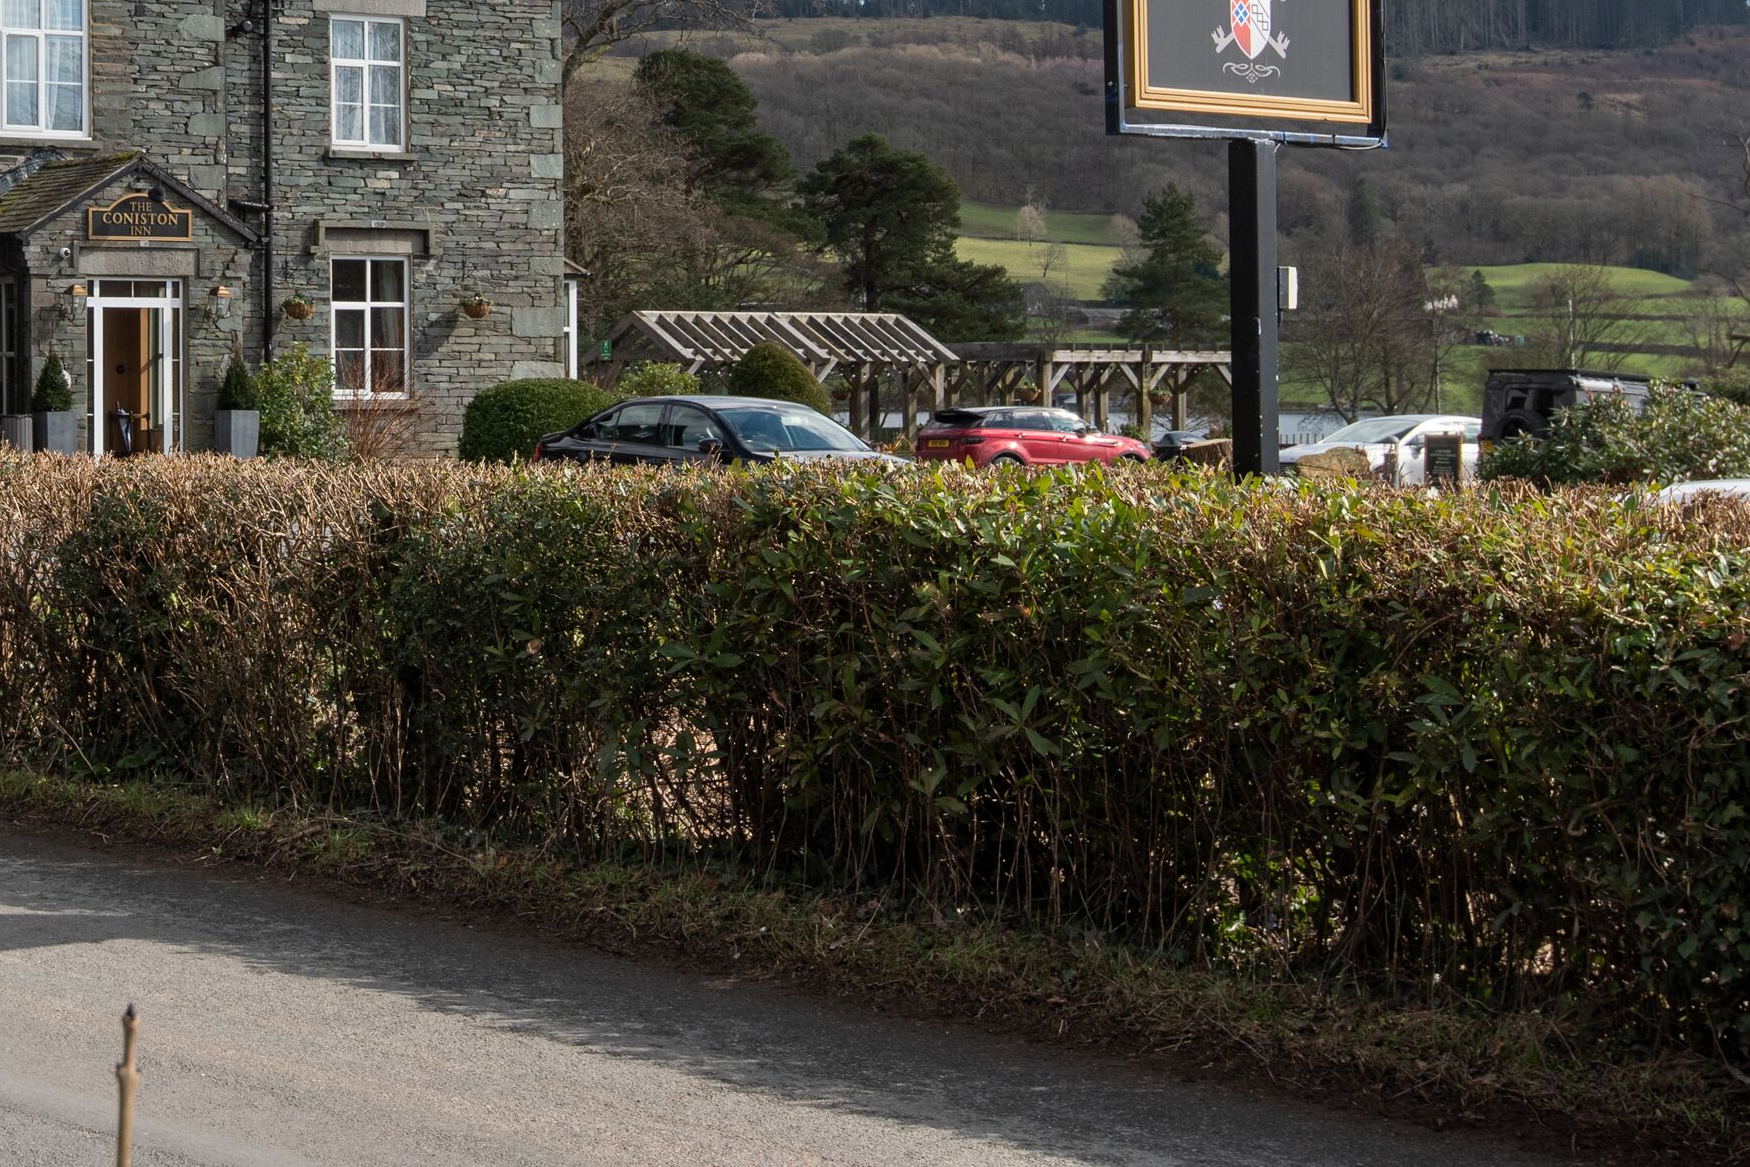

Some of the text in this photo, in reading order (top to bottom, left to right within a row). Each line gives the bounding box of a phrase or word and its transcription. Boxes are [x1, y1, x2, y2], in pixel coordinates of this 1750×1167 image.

[129, 201, 152, 212] THE
[102, 212, 178, 225] CONISTON
[130, 226, 151, 236] INN
